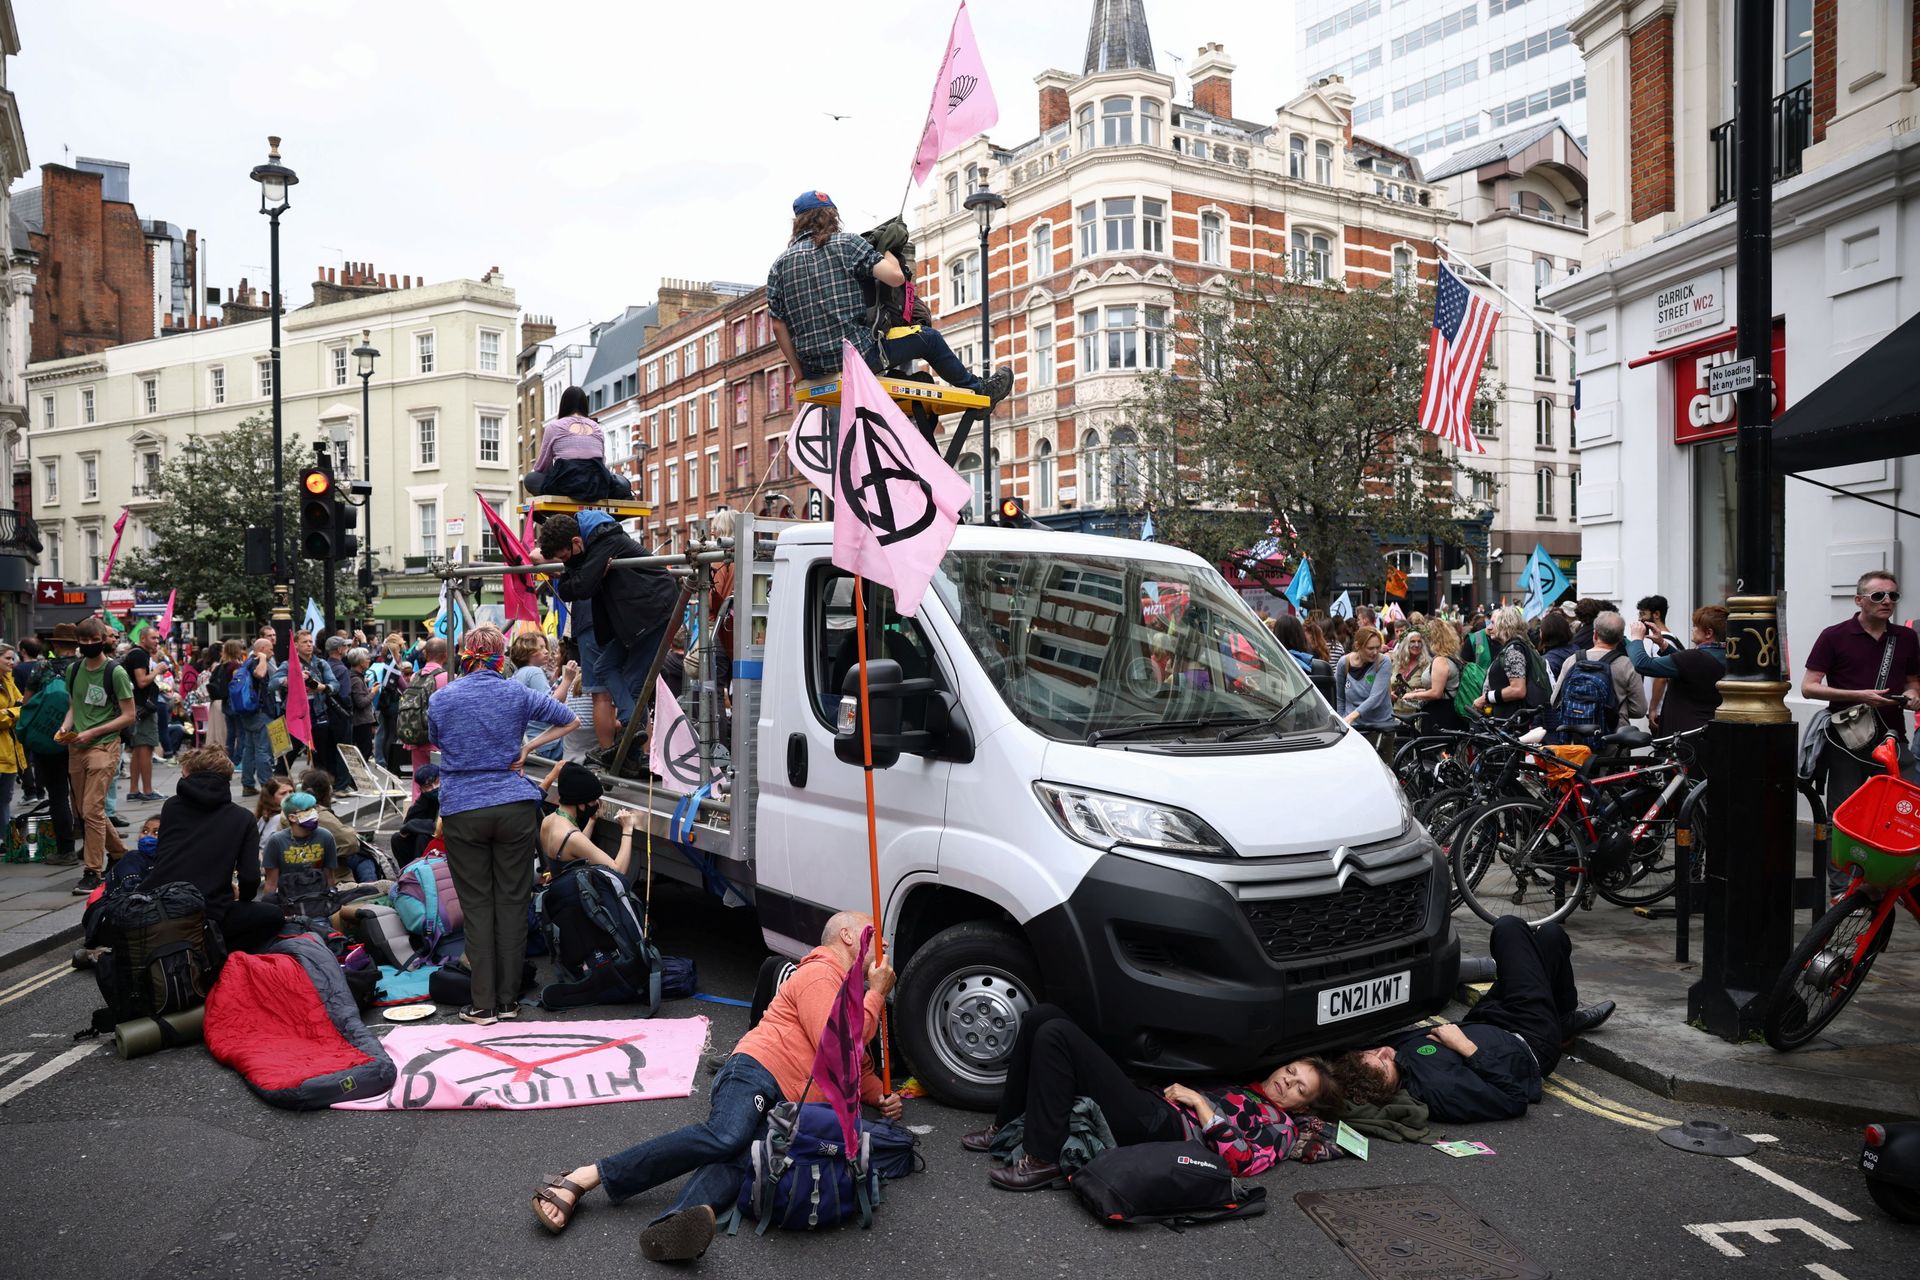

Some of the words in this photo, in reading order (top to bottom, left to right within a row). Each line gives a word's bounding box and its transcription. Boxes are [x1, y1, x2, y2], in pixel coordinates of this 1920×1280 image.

[1658, 284, 1694, 308] GARRICK
[1659, 302, 1689, 323] STREET
[1693, 294, 1713, 311] WC2
[1712, 371, 1723, 381] No
[1724, 365, 1751, 378] loading
[1712, 383, 1719, 391] at
[1721, 379, 1734, 389] any
[1735, 376, 1752, 386] time
[1330, 985, 1368, 1017] CN21
[1372, 975, 1402, 1006] KWT
